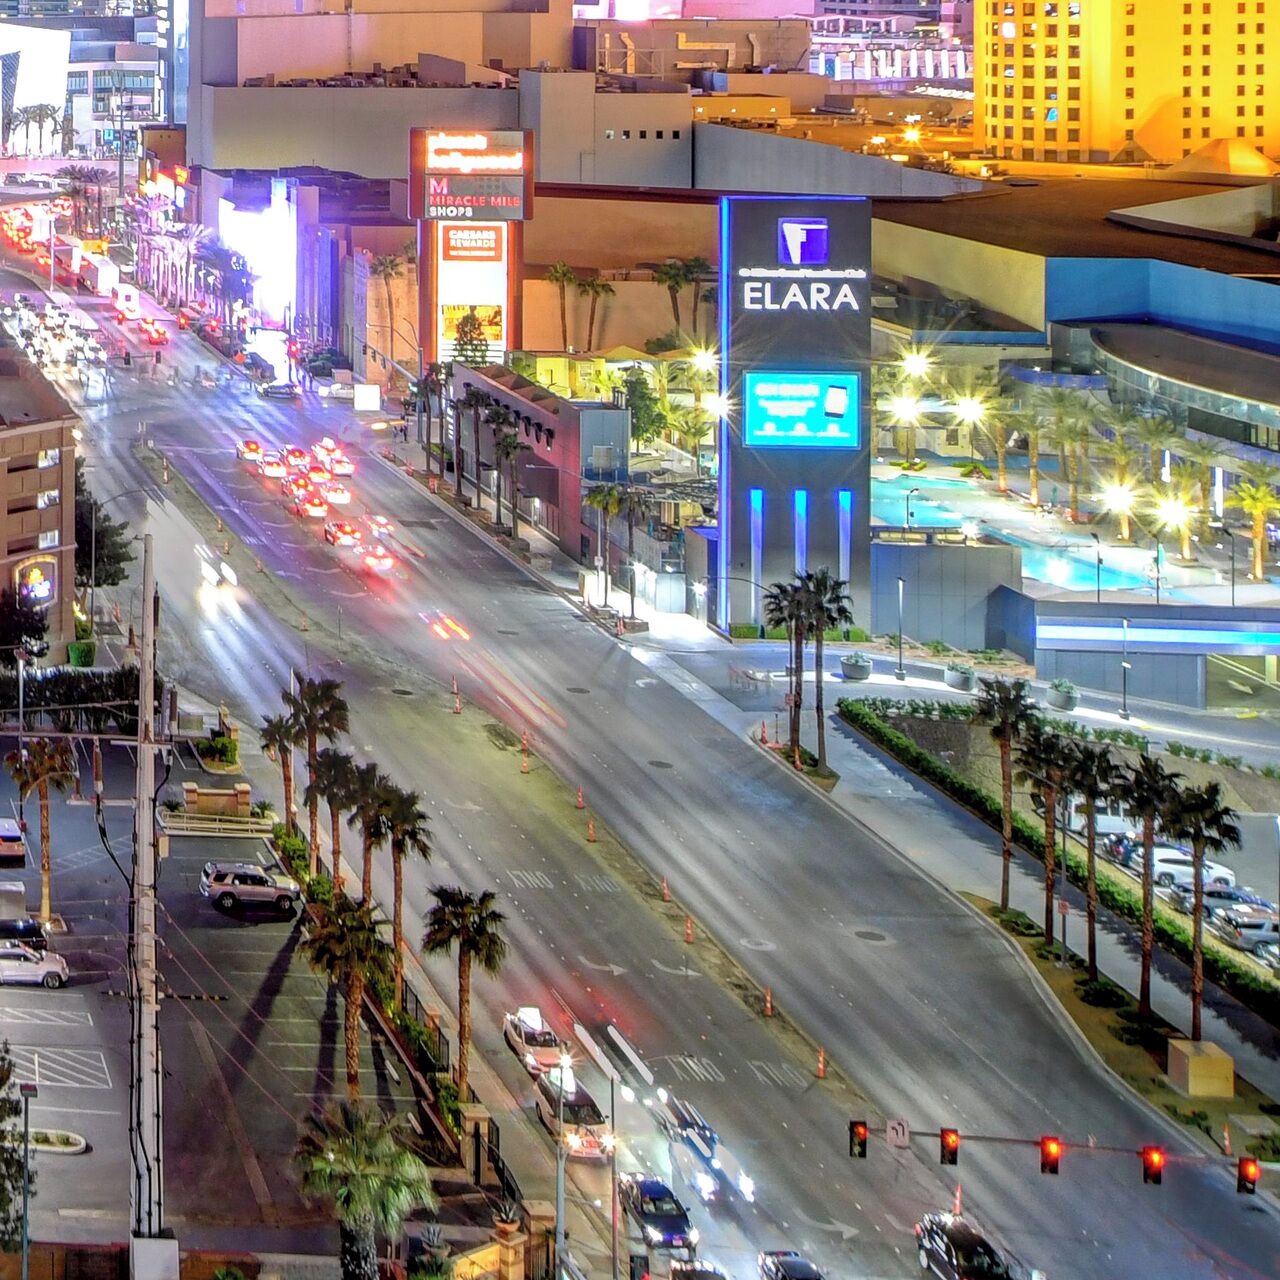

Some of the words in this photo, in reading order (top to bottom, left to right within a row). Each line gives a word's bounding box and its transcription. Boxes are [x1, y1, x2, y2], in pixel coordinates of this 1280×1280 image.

[430, 196, 486, 206] MIRACLE
[491, 196, 520, 206] MILE
[430, 206, 473, 217] SHOPS
[744, 282, 859, 310] ELARA
[505, 868, 554, 889] ONLY
[665, 1056, 726, 1082] ONLY
